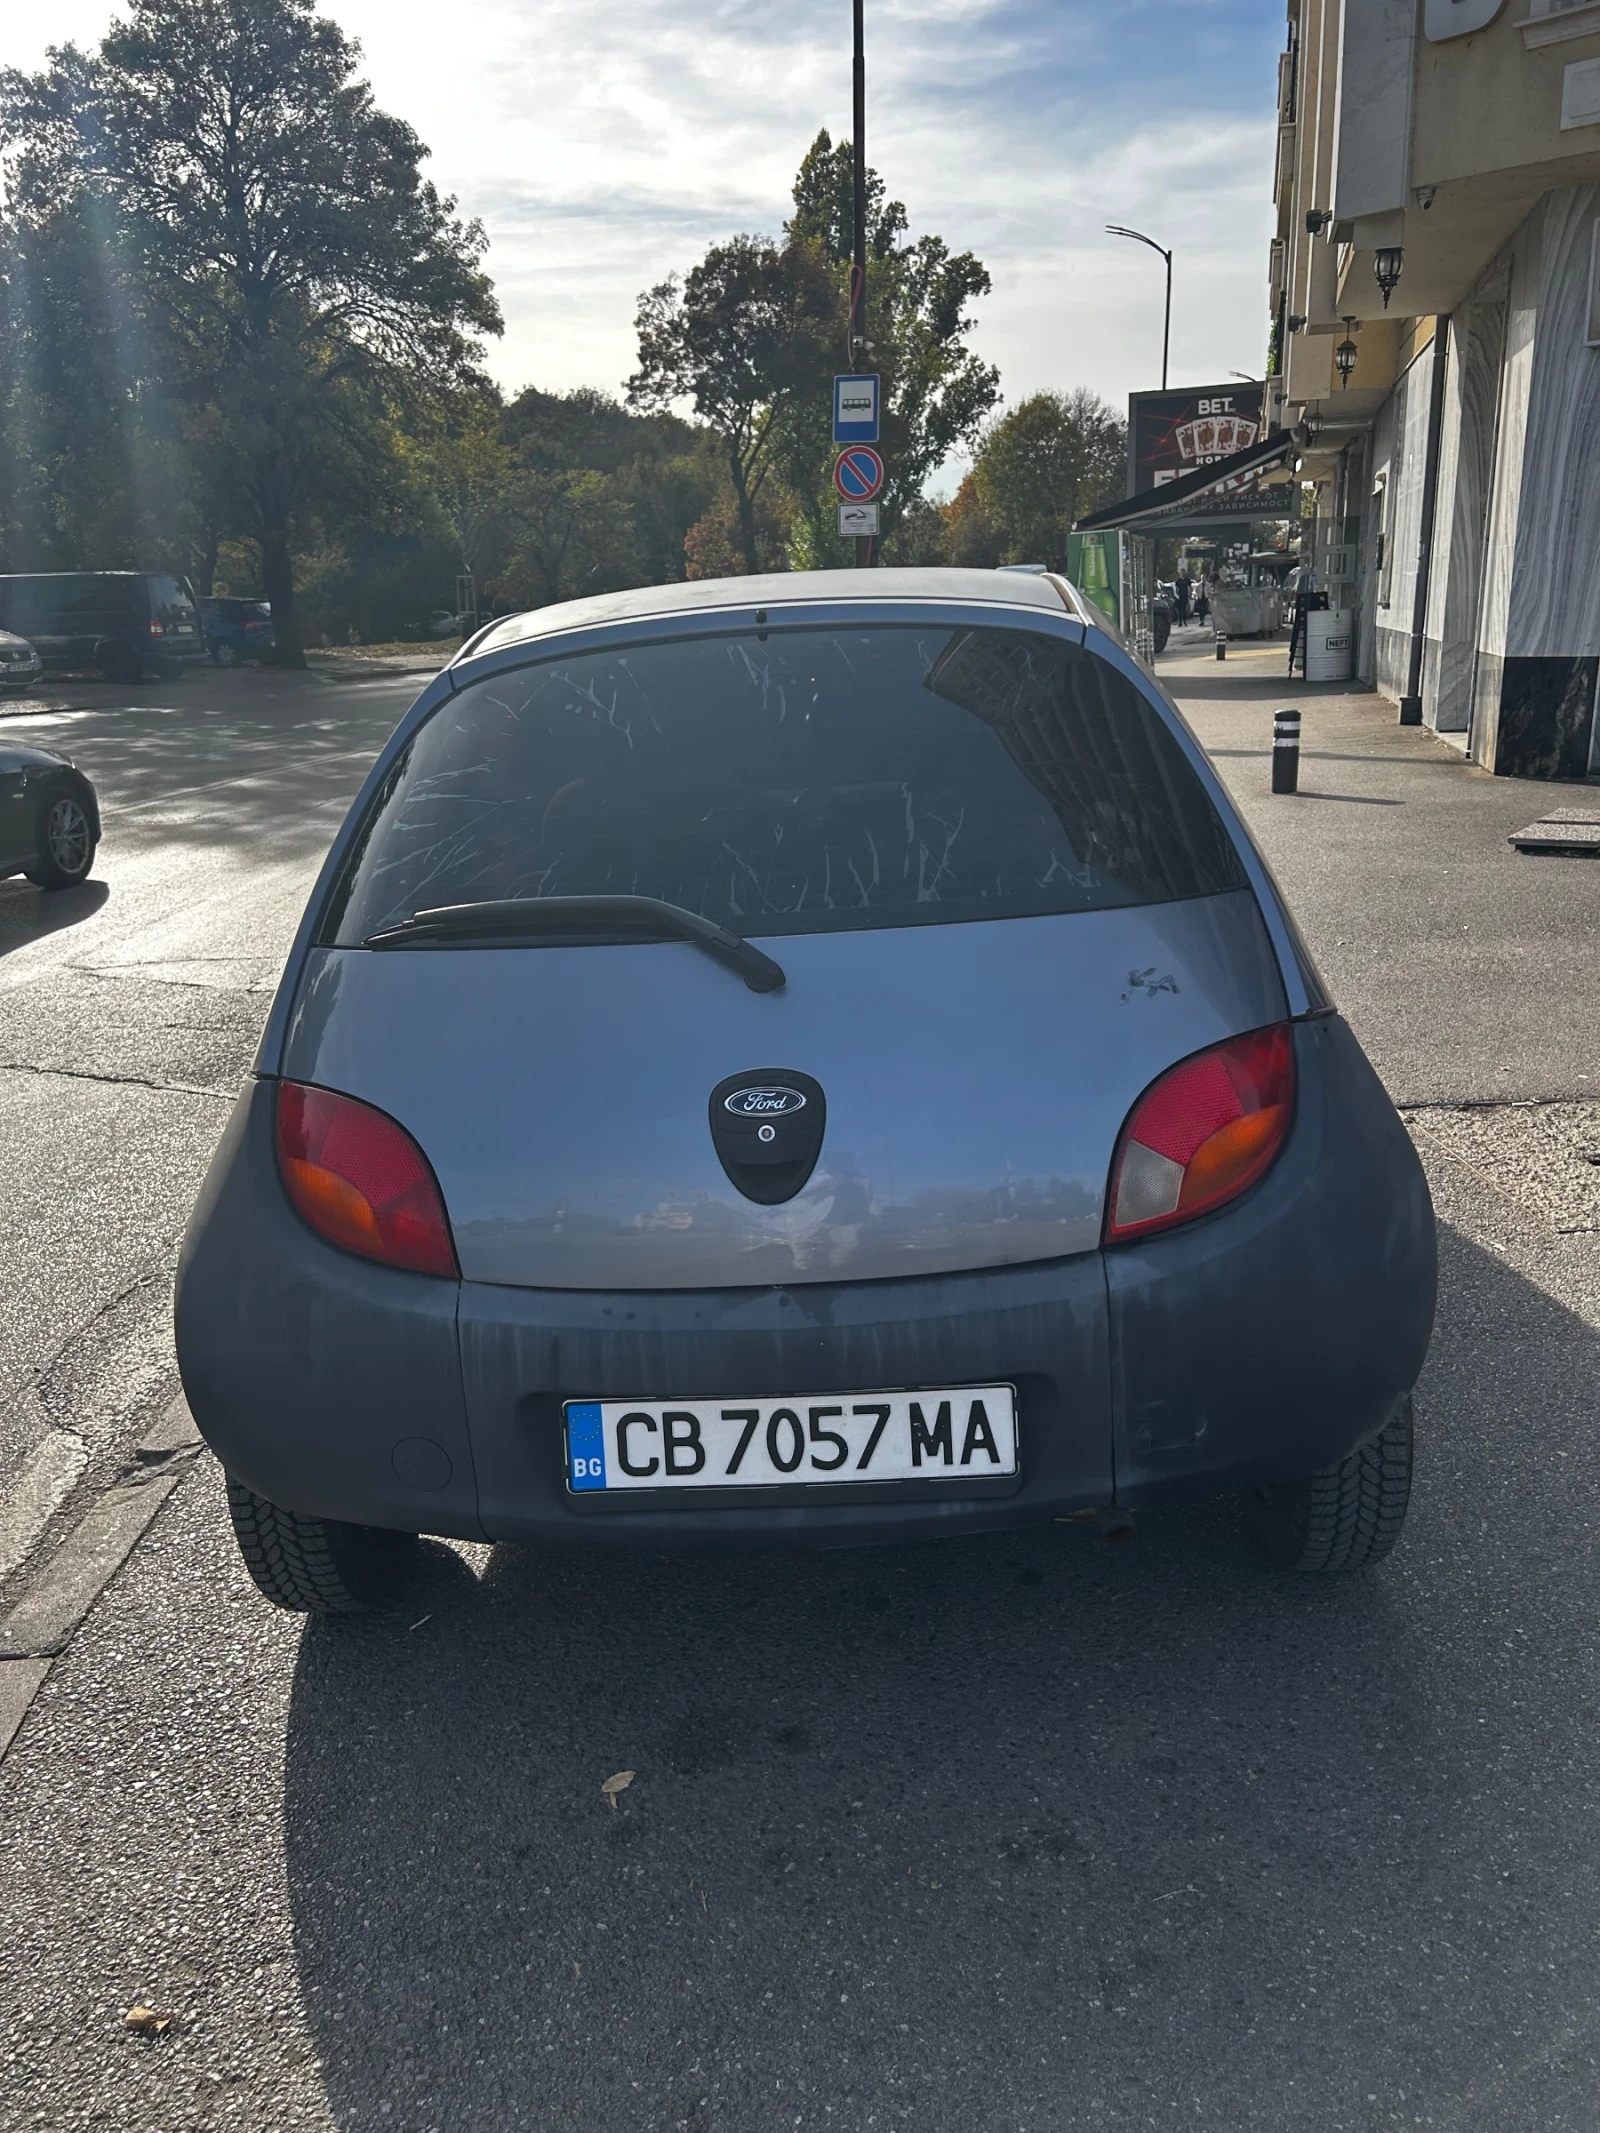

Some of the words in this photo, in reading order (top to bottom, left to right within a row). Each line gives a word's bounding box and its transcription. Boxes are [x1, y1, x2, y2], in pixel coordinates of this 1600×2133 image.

[1198, 397, 1234, 414] BET
[1235, 492, 1260, 501] РИСК
[1265, 491, 1278, 499] ОТ
[1219, 499, 1288, 511] ЗАВИСИМОСТ
[1328, 639, 1348, 648] NEFT
[743, 1092, 788, 1111] Ford
[615, 1410, 706, 1477] CB
[720, 1404, 892, 1475] 7057
[908, 1399, 1001, 1467] MA
[573, 1457, 602, 1478] BG
